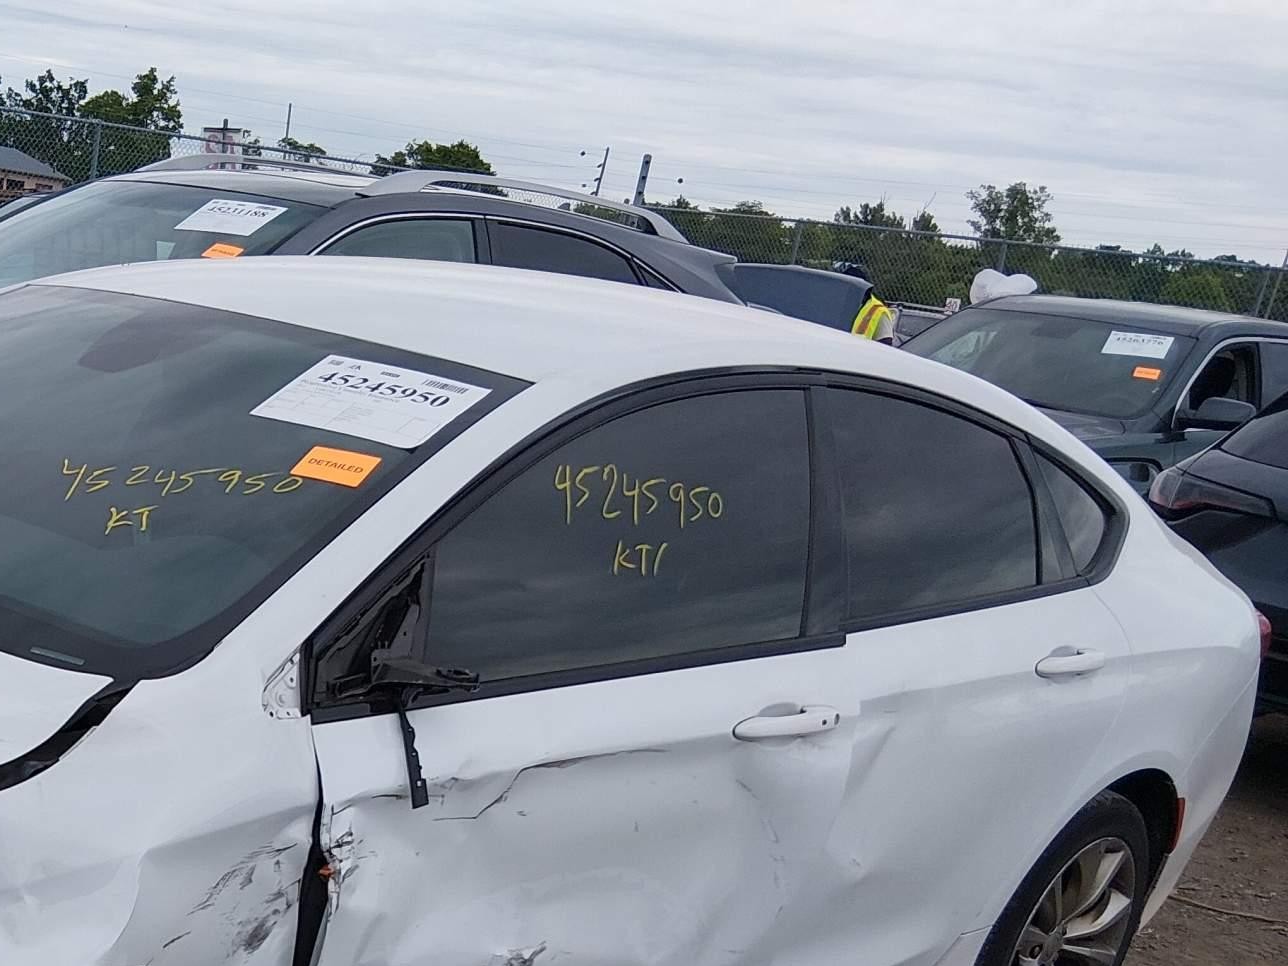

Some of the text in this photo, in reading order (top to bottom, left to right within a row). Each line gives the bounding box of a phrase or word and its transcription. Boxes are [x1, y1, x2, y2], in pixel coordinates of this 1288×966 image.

[317, 371, 451, 408] 45245950
[307, 456, 365, 475] DETAILED
[554, 463, 724, 529] 45245950
[104, 504, 160, 536] KT
